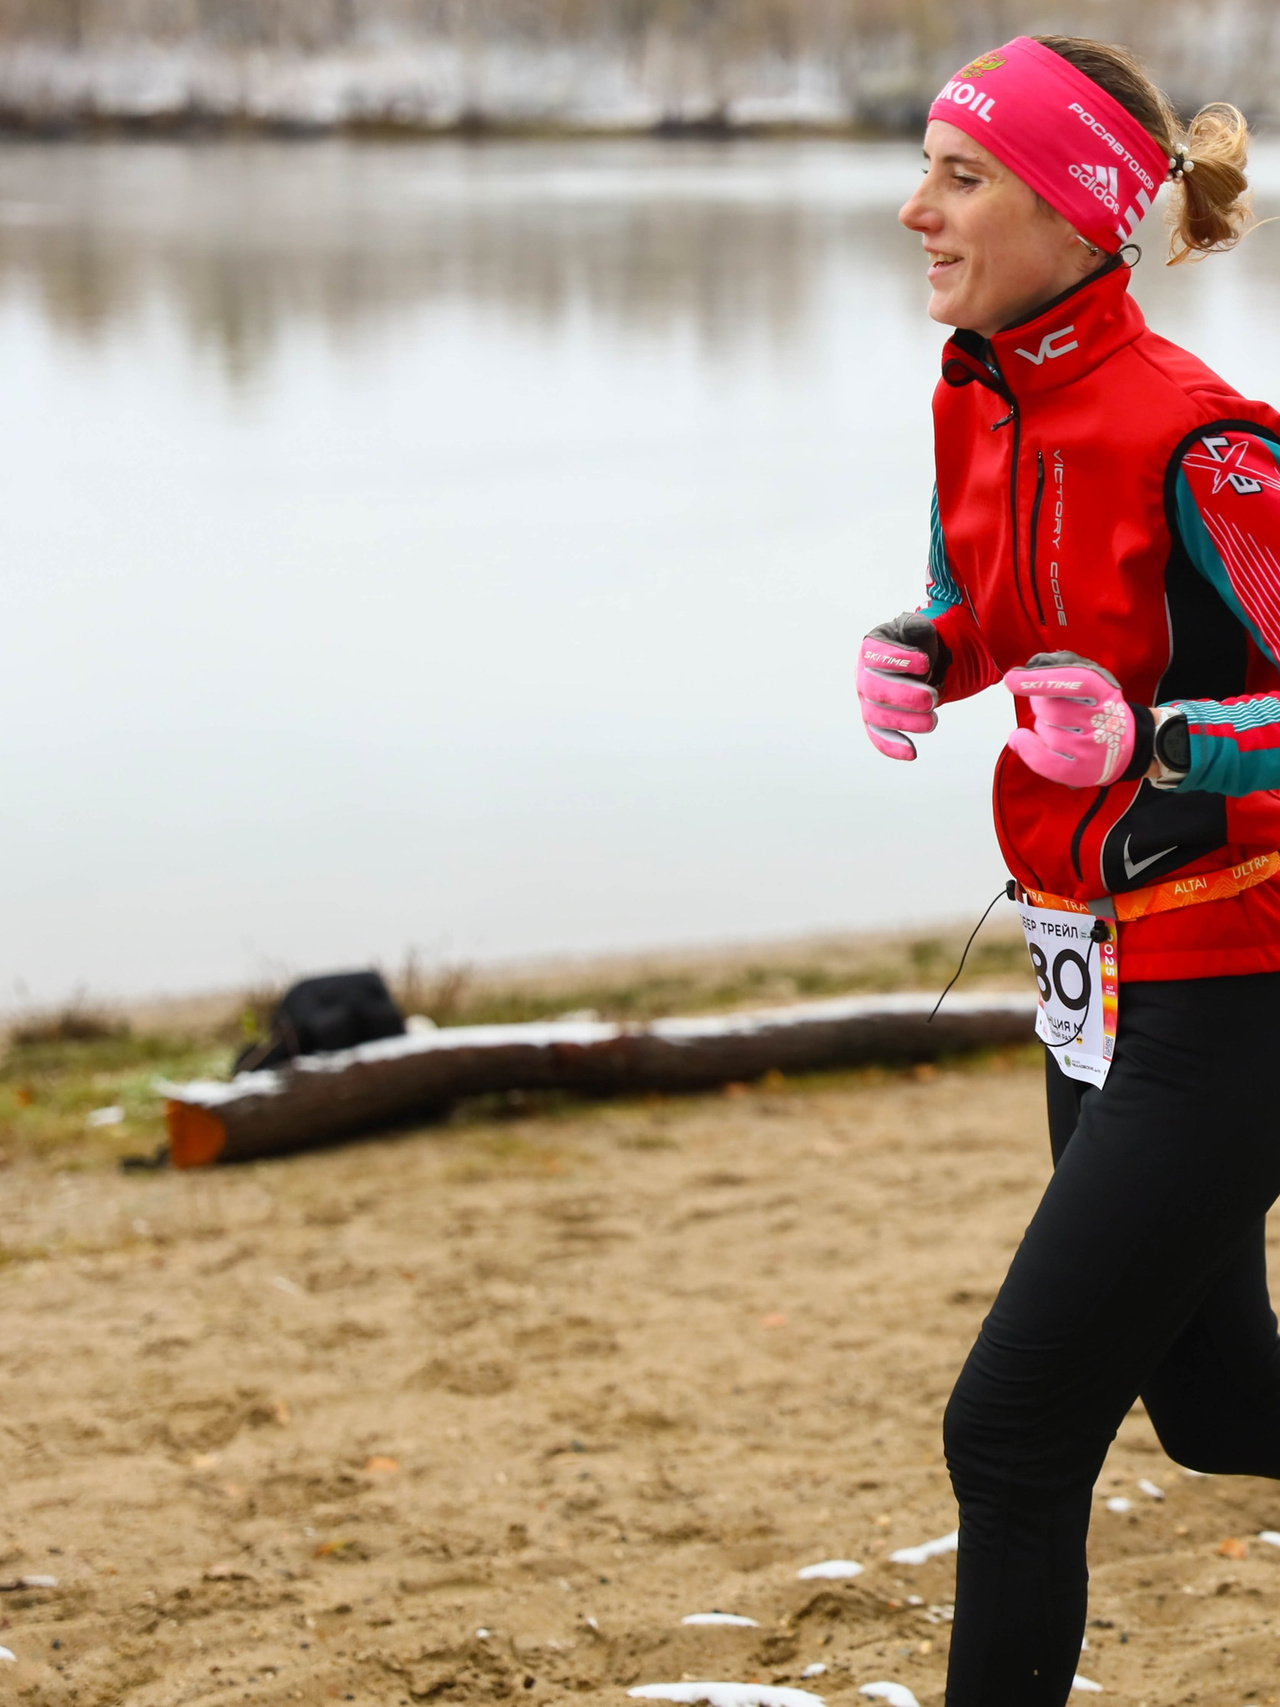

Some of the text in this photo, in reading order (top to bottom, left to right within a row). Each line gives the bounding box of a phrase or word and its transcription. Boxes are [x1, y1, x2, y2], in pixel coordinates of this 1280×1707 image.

[936, 80, 996, 123] KOIL
[1068, 164, 1120, 215] adidas
[1014, 324, 1079, 366] VC
[1050, 449, 1068, 627] VICTORY CODE
[863, 651, 912, 668] SKI TIME
[1020, 680, 1083, 690] SKI TIME
[1174, 855, 1269, 896] ALTAI ULTRA
[1040, 921, 1079, 939] ТРЕЙЛ
